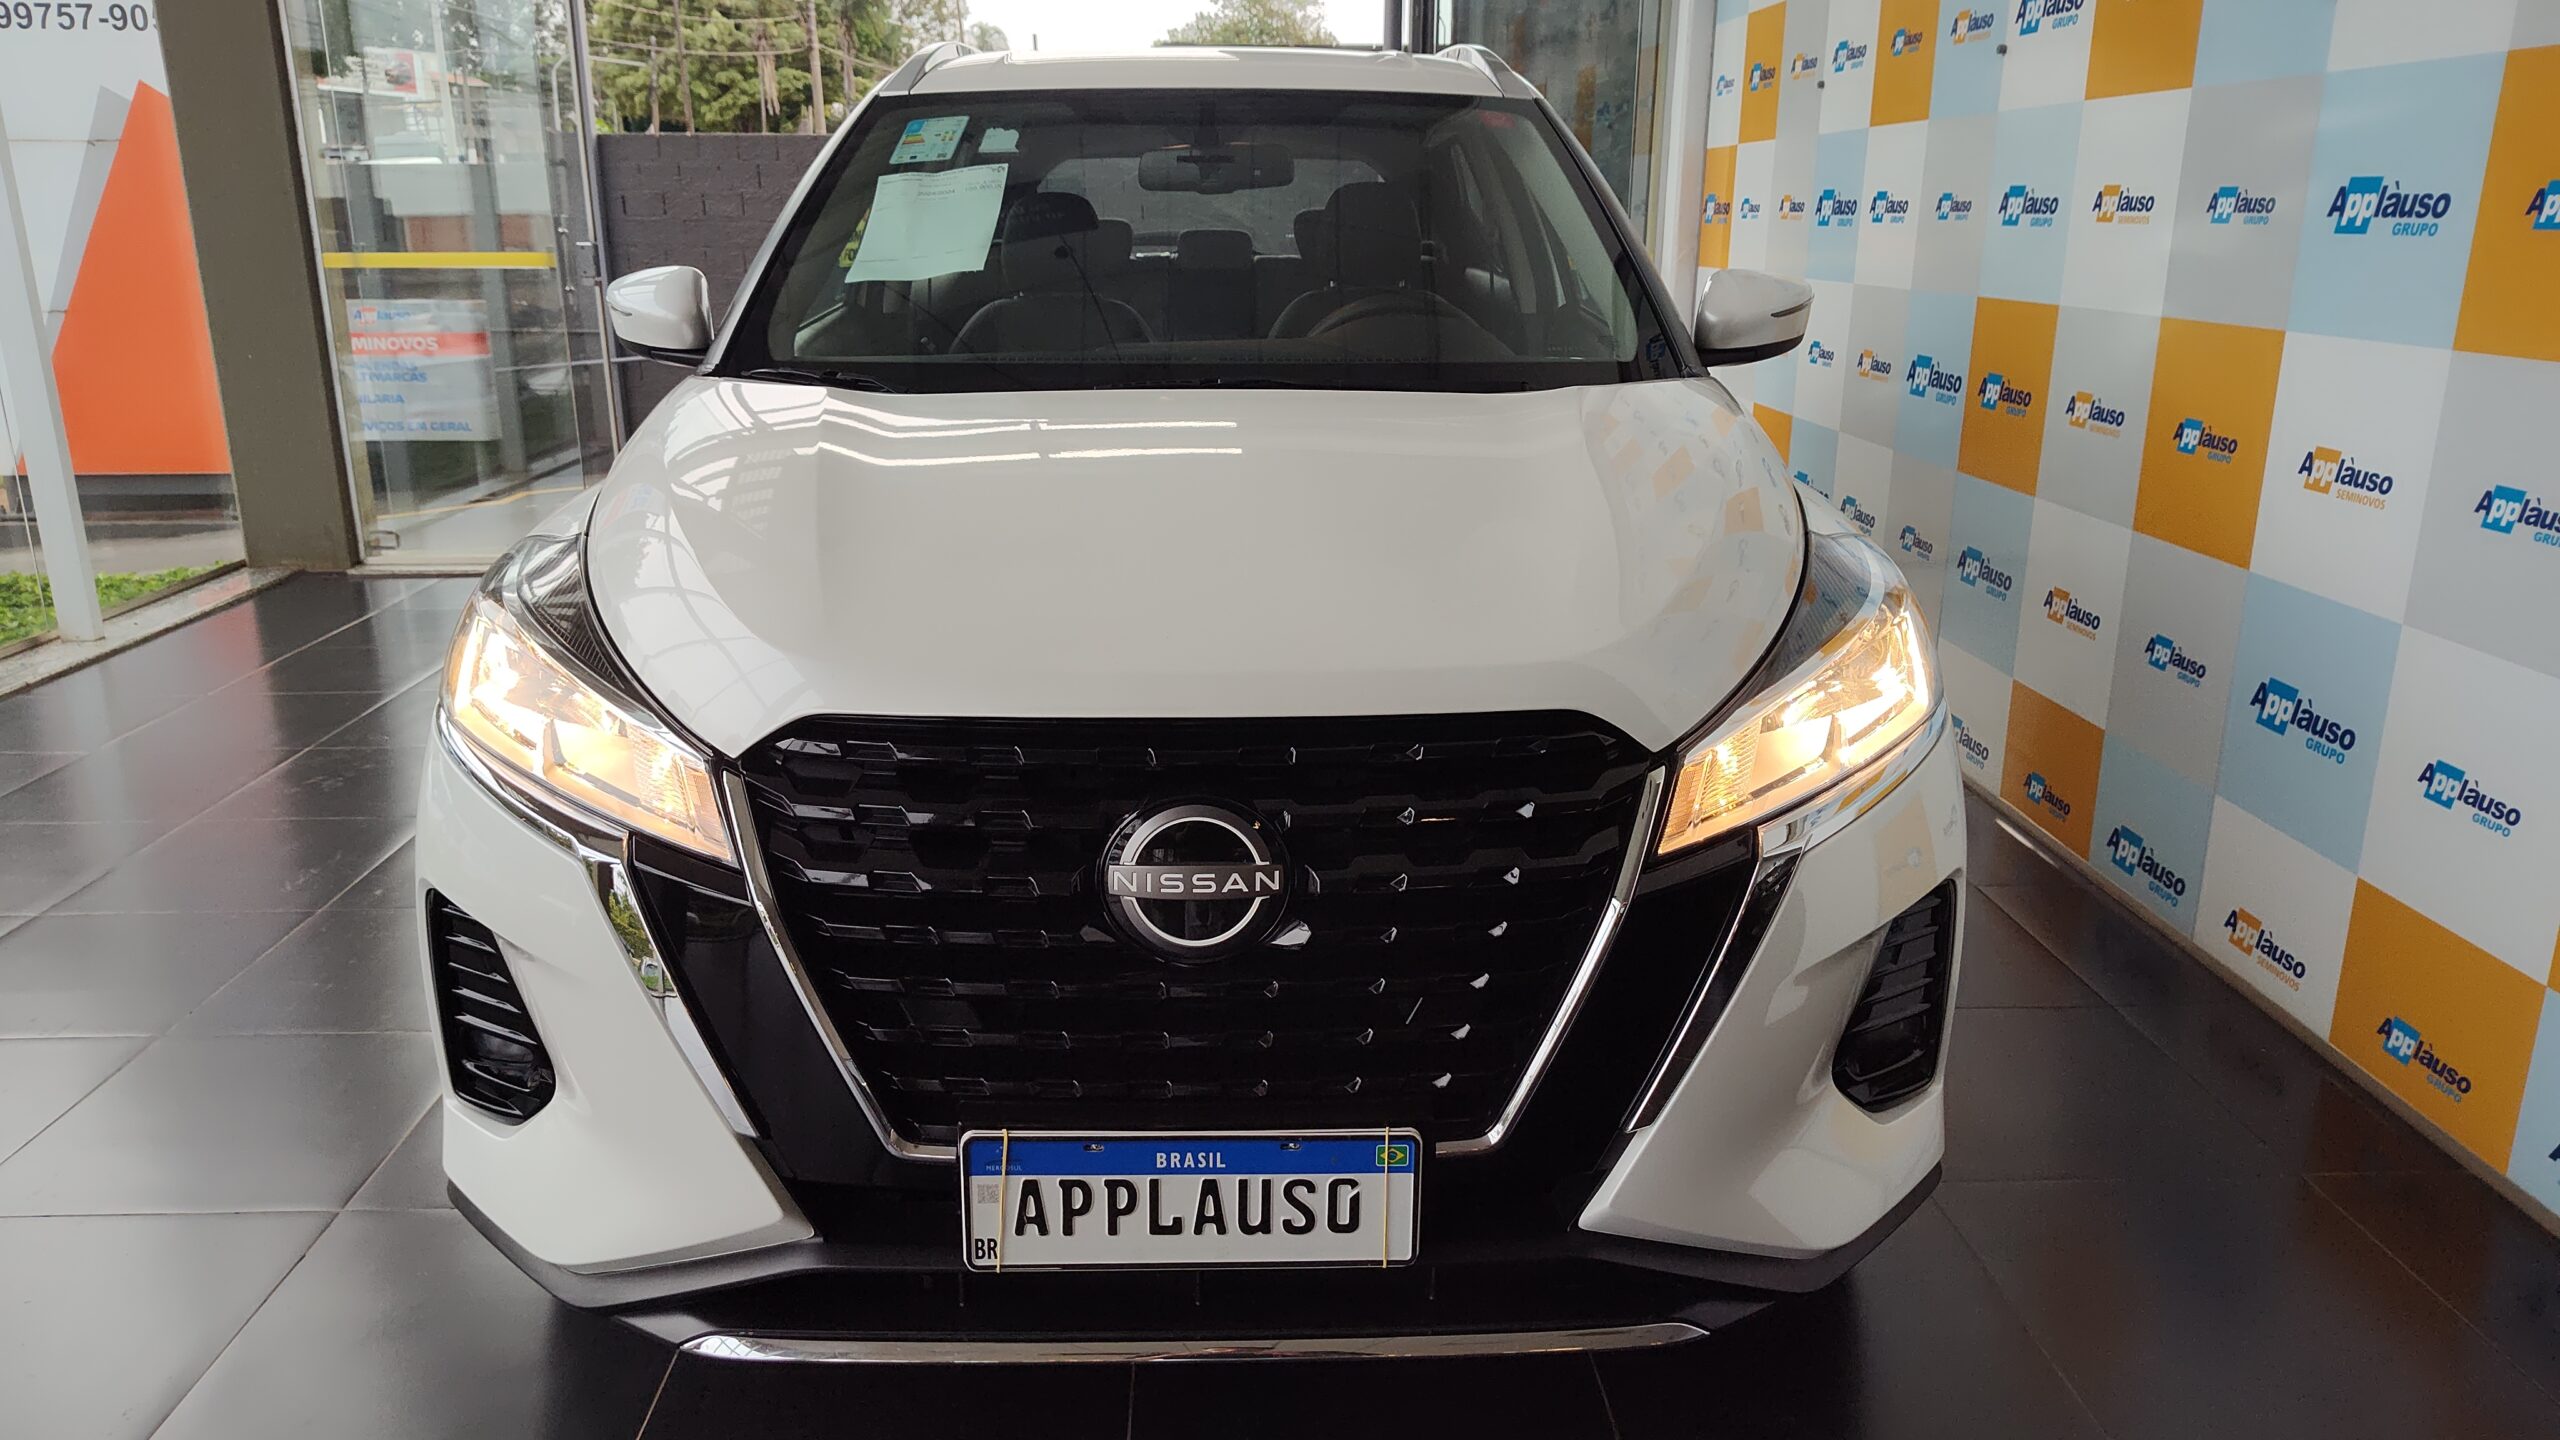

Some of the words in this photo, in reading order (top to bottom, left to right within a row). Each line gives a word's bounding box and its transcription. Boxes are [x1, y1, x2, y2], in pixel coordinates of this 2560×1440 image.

[0, 2, 157, 31] 99757-90
[2052, 14, 2079, 30] GRUPO
[2392, 223, 2439, 237] GRUPO
[351, 337, 439, 351] MINOVOS
[431, 422, 472, 431] GERAL
[2336, 488, 2386, 510] SEMINOVOS
[2533, 531, 2560, 547] GRU
[2177, 671, 2201, 688] GRUPO
[2305, 736, 2346, 765] GRUPO
[2471, 812, 2511, 838] GRUPO
[1113, 870, 1280, 893] NISSAN
[1156, 1152, 1227, 1169] BRASIL
[974, 1238, 998, 1260] BR
